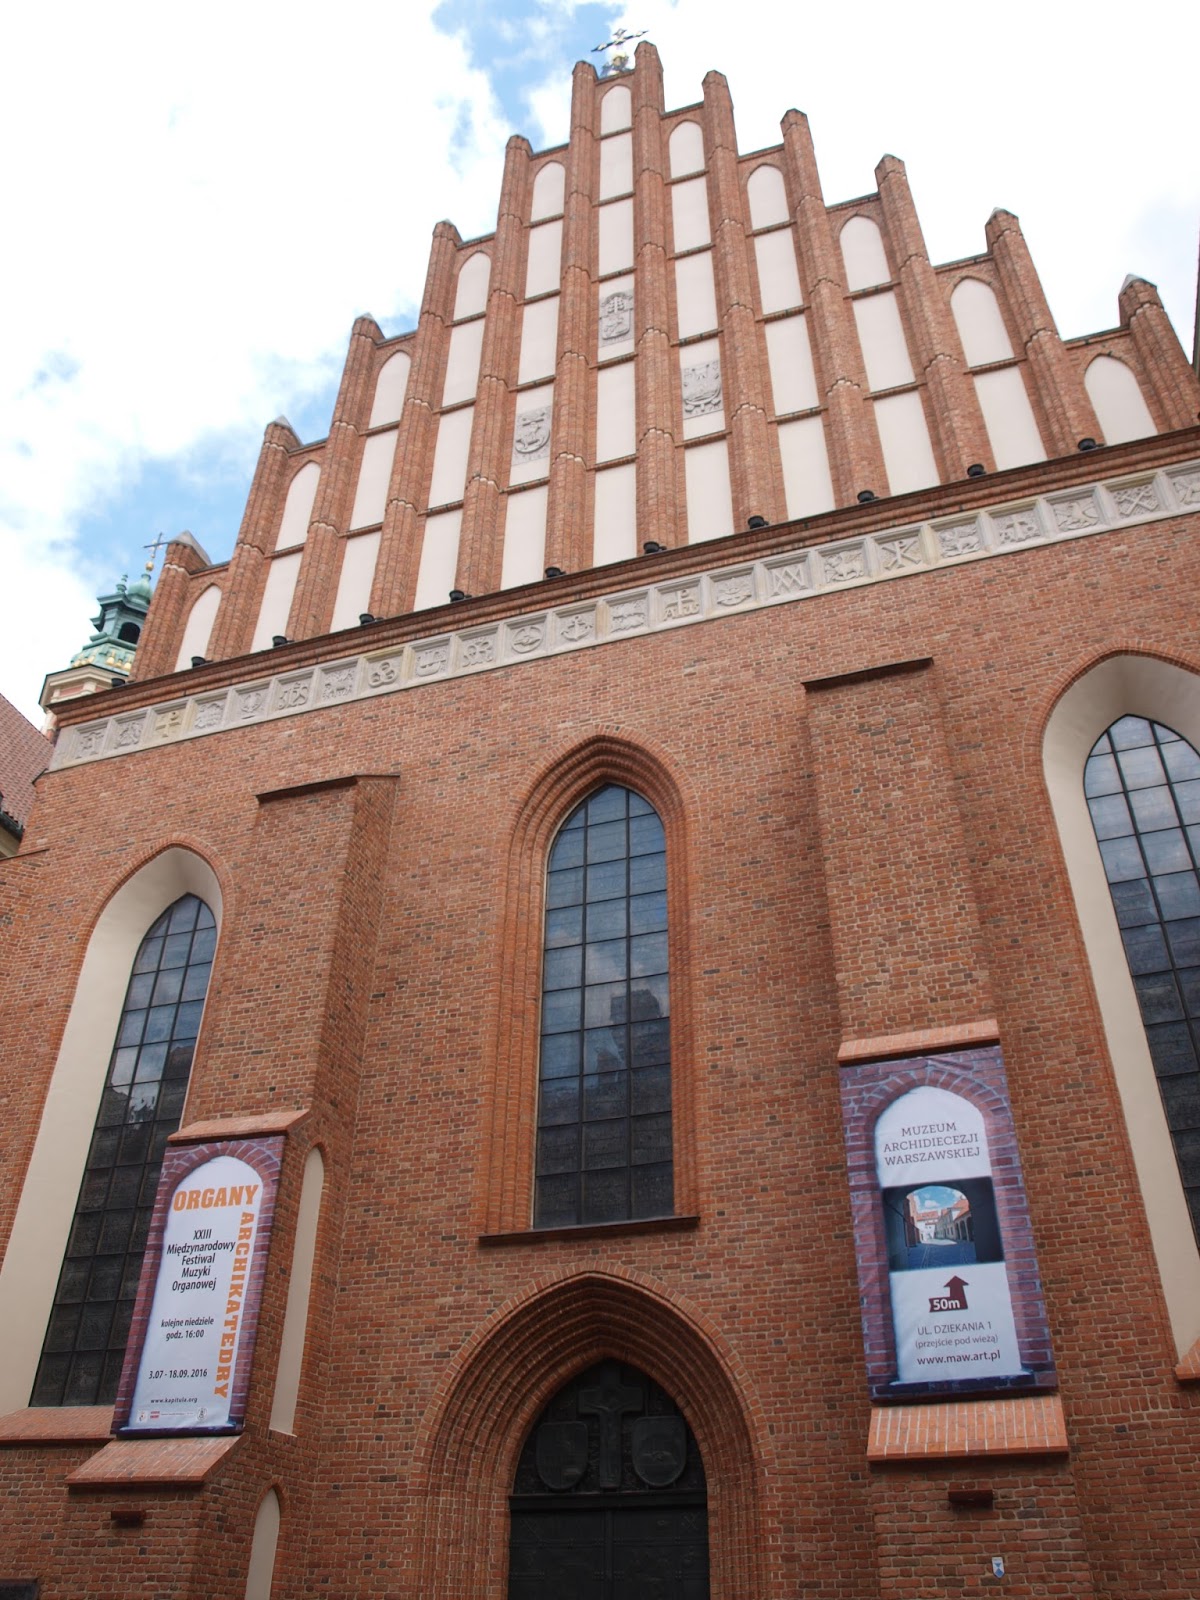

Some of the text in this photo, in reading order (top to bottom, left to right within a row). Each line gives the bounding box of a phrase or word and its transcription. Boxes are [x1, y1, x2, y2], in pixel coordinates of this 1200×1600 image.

[901, 1122, 957, 1137] MUZEUM
[883, 1133, 979, 1153] ARCHIDIECEZJI
[884, 1147, 981, 1166] WARSZAWSKIEJ
[173, 1184, 259, 1212] ORGANY
[193, 1229, 212, 1240] XXIII
[166, 1240, 236, 1257] Międzynarodowy
[181, 1253, 216, 1266] Festiwal
[181, 1266, 212, 1279] Muzyki
[172, 1278, 217, 1294] Organowej
[214, 1211, 255, 1399] ARCHIKATEDRY
[933, 1299, 961, 1311] 50m
[161, 1316, 214, 1328] kolejne niedziele
[917, 1321, 992, 1336] UL. DZIEKANIA 1
[166, 1329, 204, 1341] godz. 16:00
[915, 1334, 999, 1350] (przejście pod wieżą)
[917, 1349, 1001, 1366] www.maw.art.pl
[149, 1370, 164, 1380] 3.07
[169, 1369, 189, 1379] 18.09.
[191, 1368, 208, 1378] 2016
